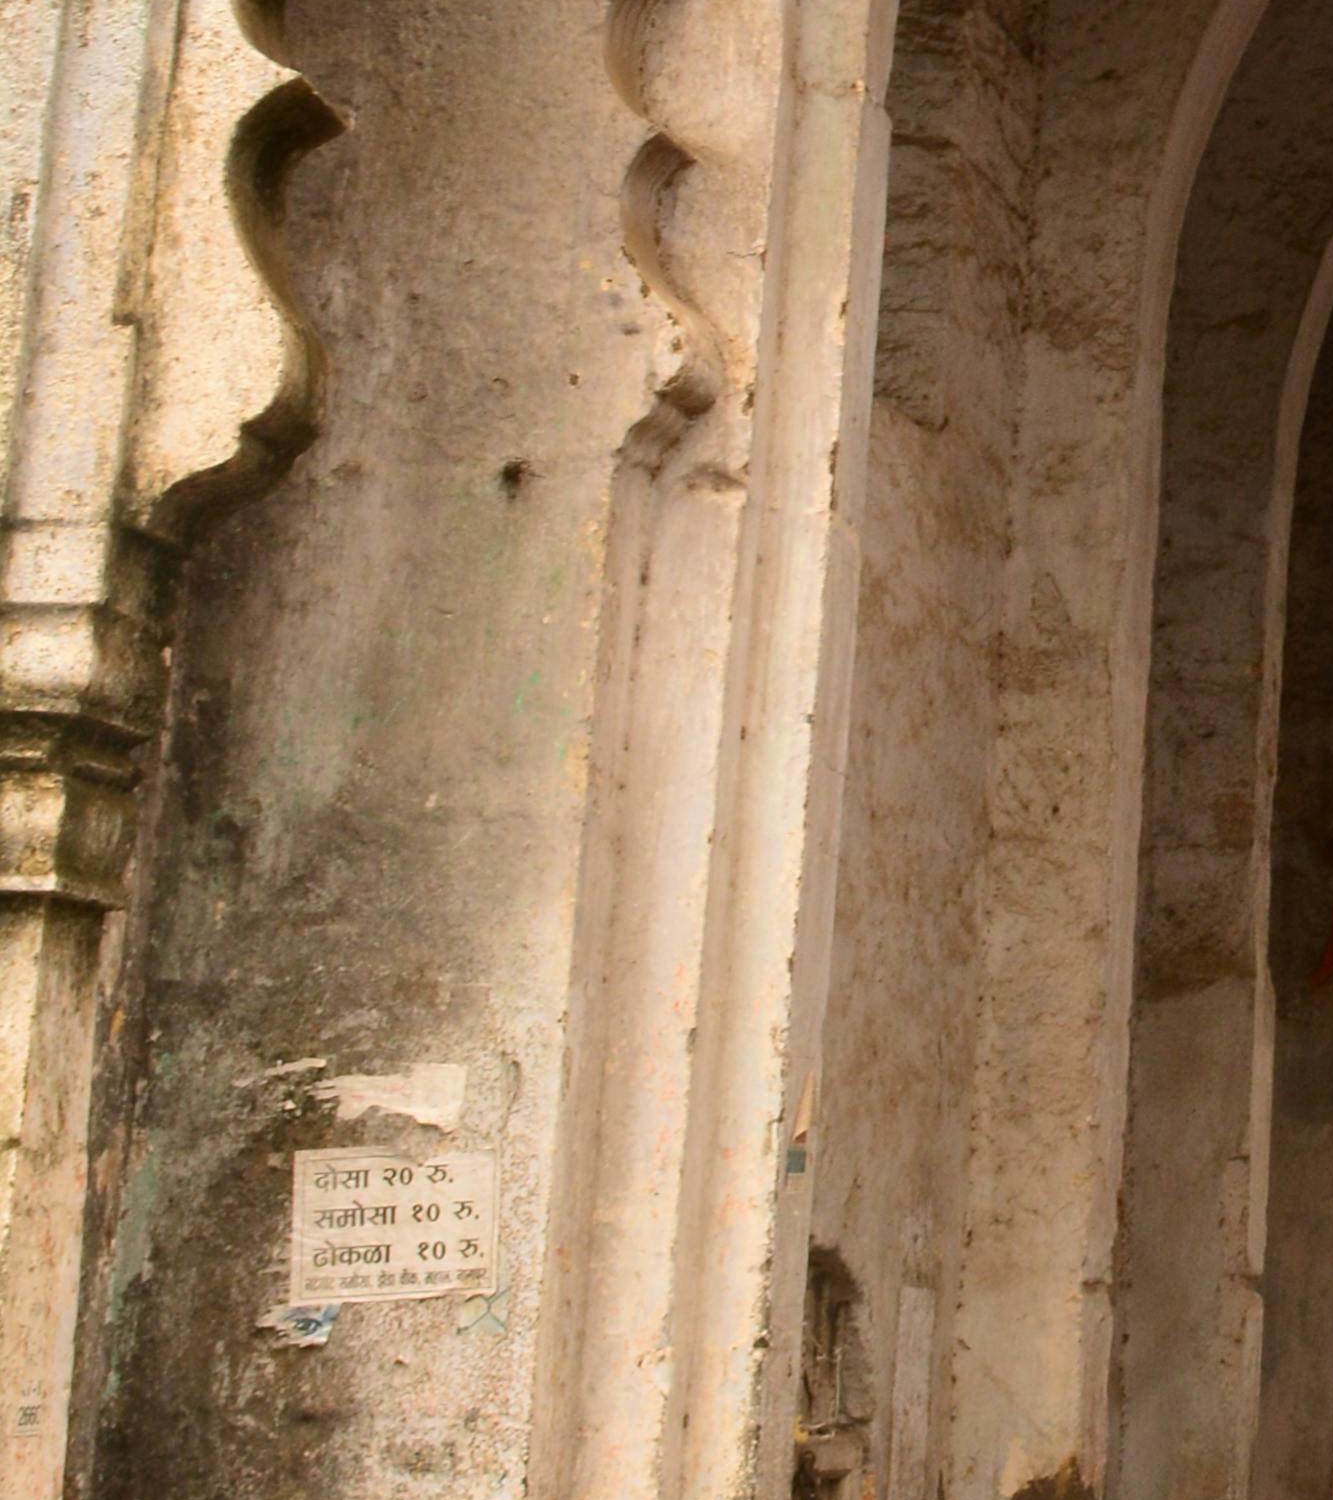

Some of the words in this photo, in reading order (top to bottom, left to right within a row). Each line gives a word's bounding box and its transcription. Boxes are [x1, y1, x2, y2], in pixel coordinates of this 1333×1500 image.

[314, 1165, 371, 1192] दोसा
[383, 1167, 413, 1186] २०
[314, 1200, 396, 1228] समोसा
[412, 1203, 440, 1222] १०
[313, 1241, 392, 1267] ढोकळा
[418, 1241, 446, 1261] १०
